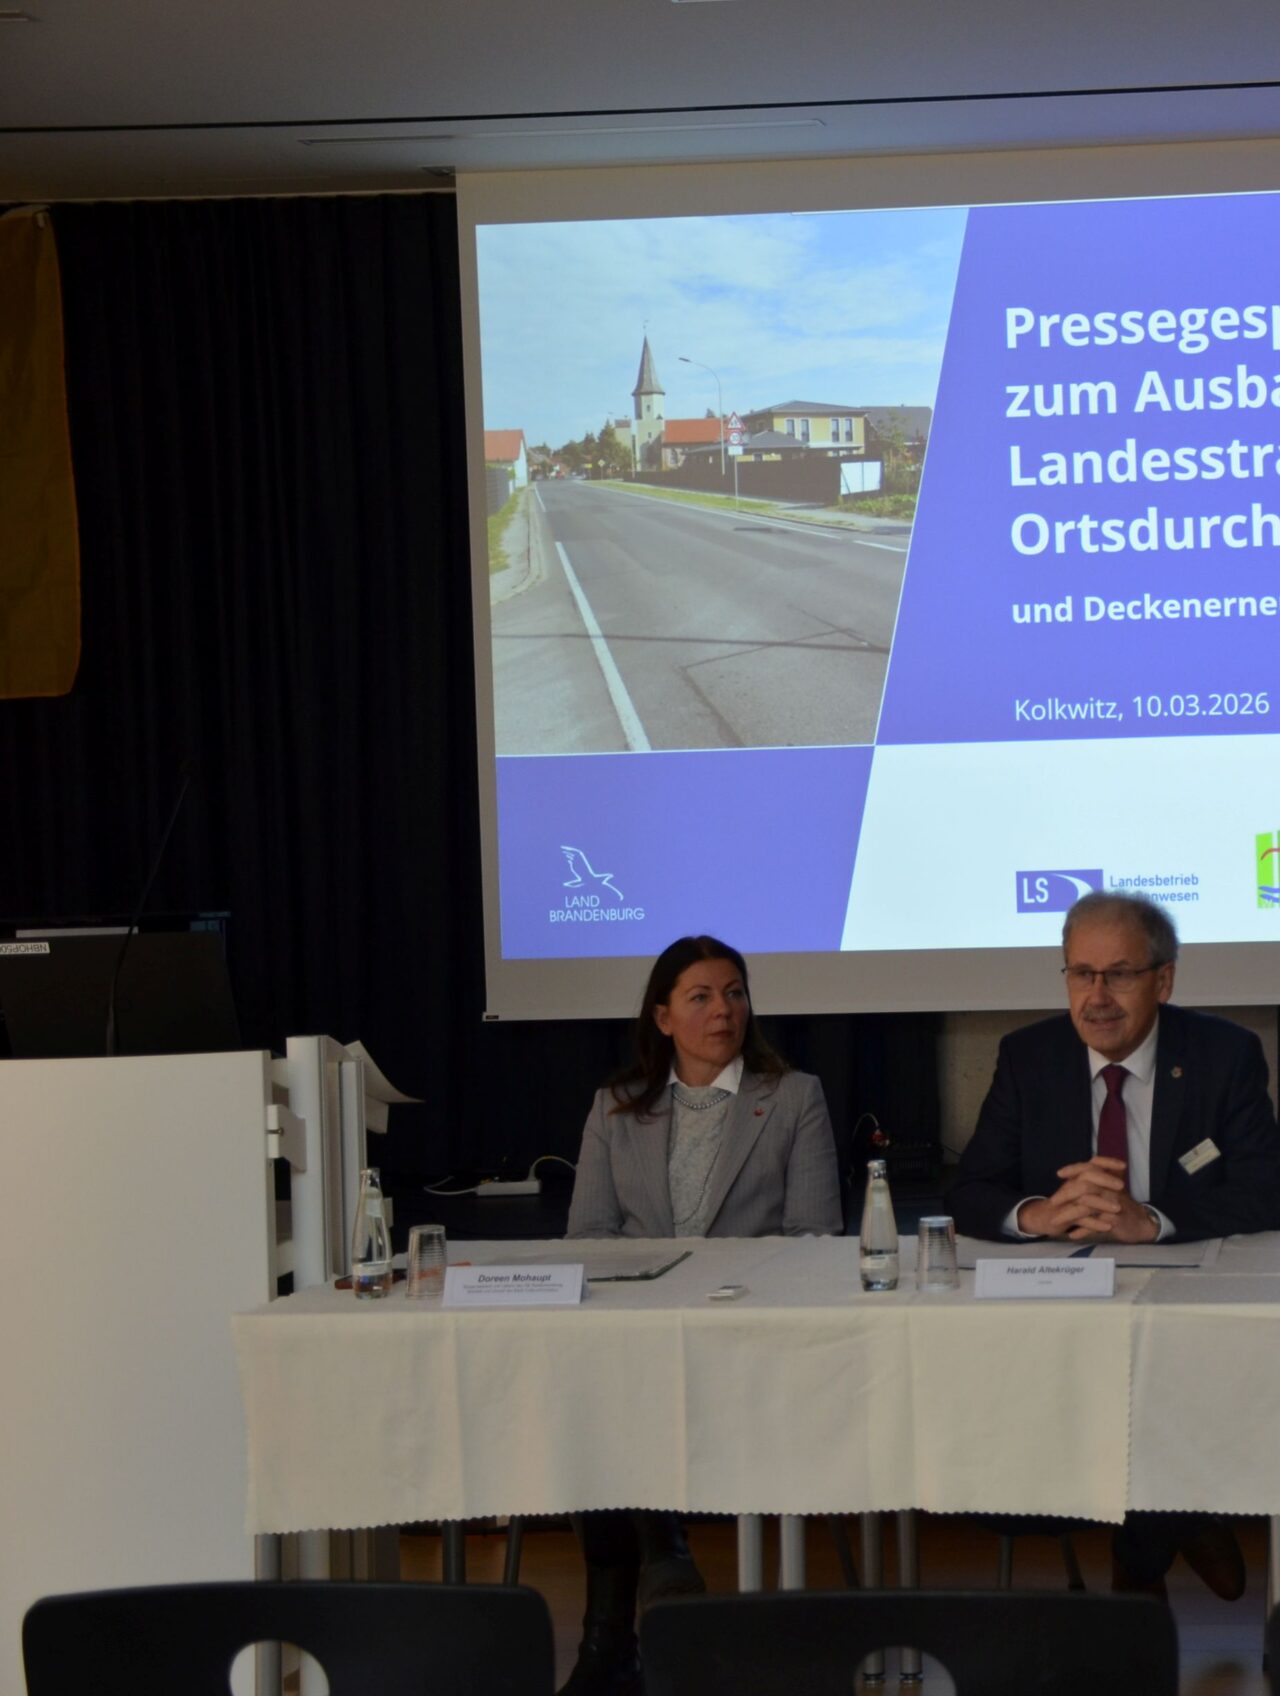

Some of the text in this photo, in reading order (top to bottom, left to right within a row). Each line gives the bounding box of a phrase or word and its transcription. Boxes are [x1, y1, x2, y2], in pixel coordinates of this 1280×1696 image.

[1005, 381, 1117, 418] zum
[1012, 595, 1074, 624] und
[1014, 692, 1270, 724] Kolkwitz, 10.03.2026
[1022, 877, 1049, 904] LS
[1109, 873, 1200, 888] Landesbetrieb
[564, 895, 600, 908] LAND
[549, 907, 645, 922] BRANDENBURG
[478, 1274, 552, 1283] Doreen Mohaupt
